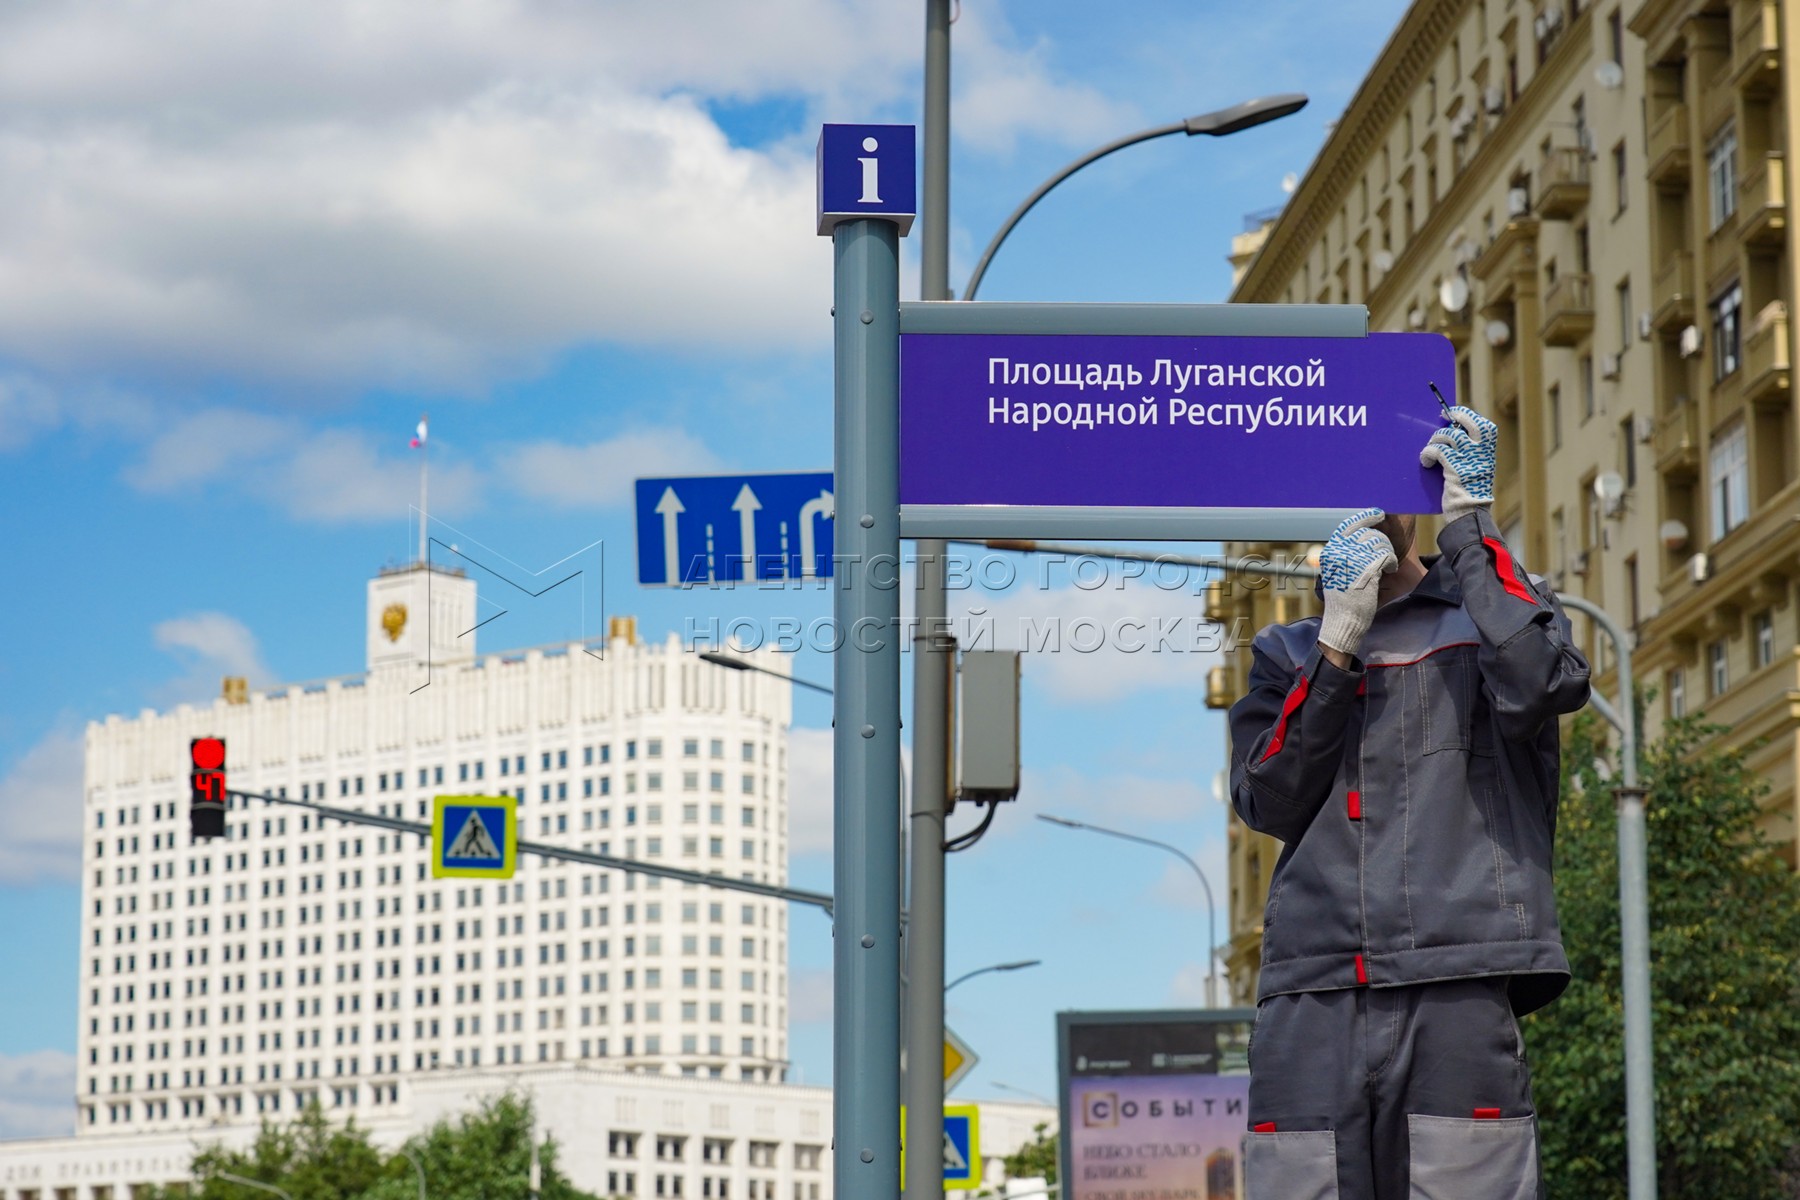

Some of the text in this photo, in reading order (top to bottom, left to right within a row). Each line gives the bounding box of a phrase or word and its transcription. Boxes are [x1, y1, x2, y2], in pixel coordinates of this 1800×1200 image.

[857, 136, 884, 204] i
[988, 357, 1326, 393] Площадь Луганской
[987, 396, 1368, 433] Народной Республики
[195, 772, 226, 802] 47
[1091, 1098, 1243, 1118] СОБЫТИ
